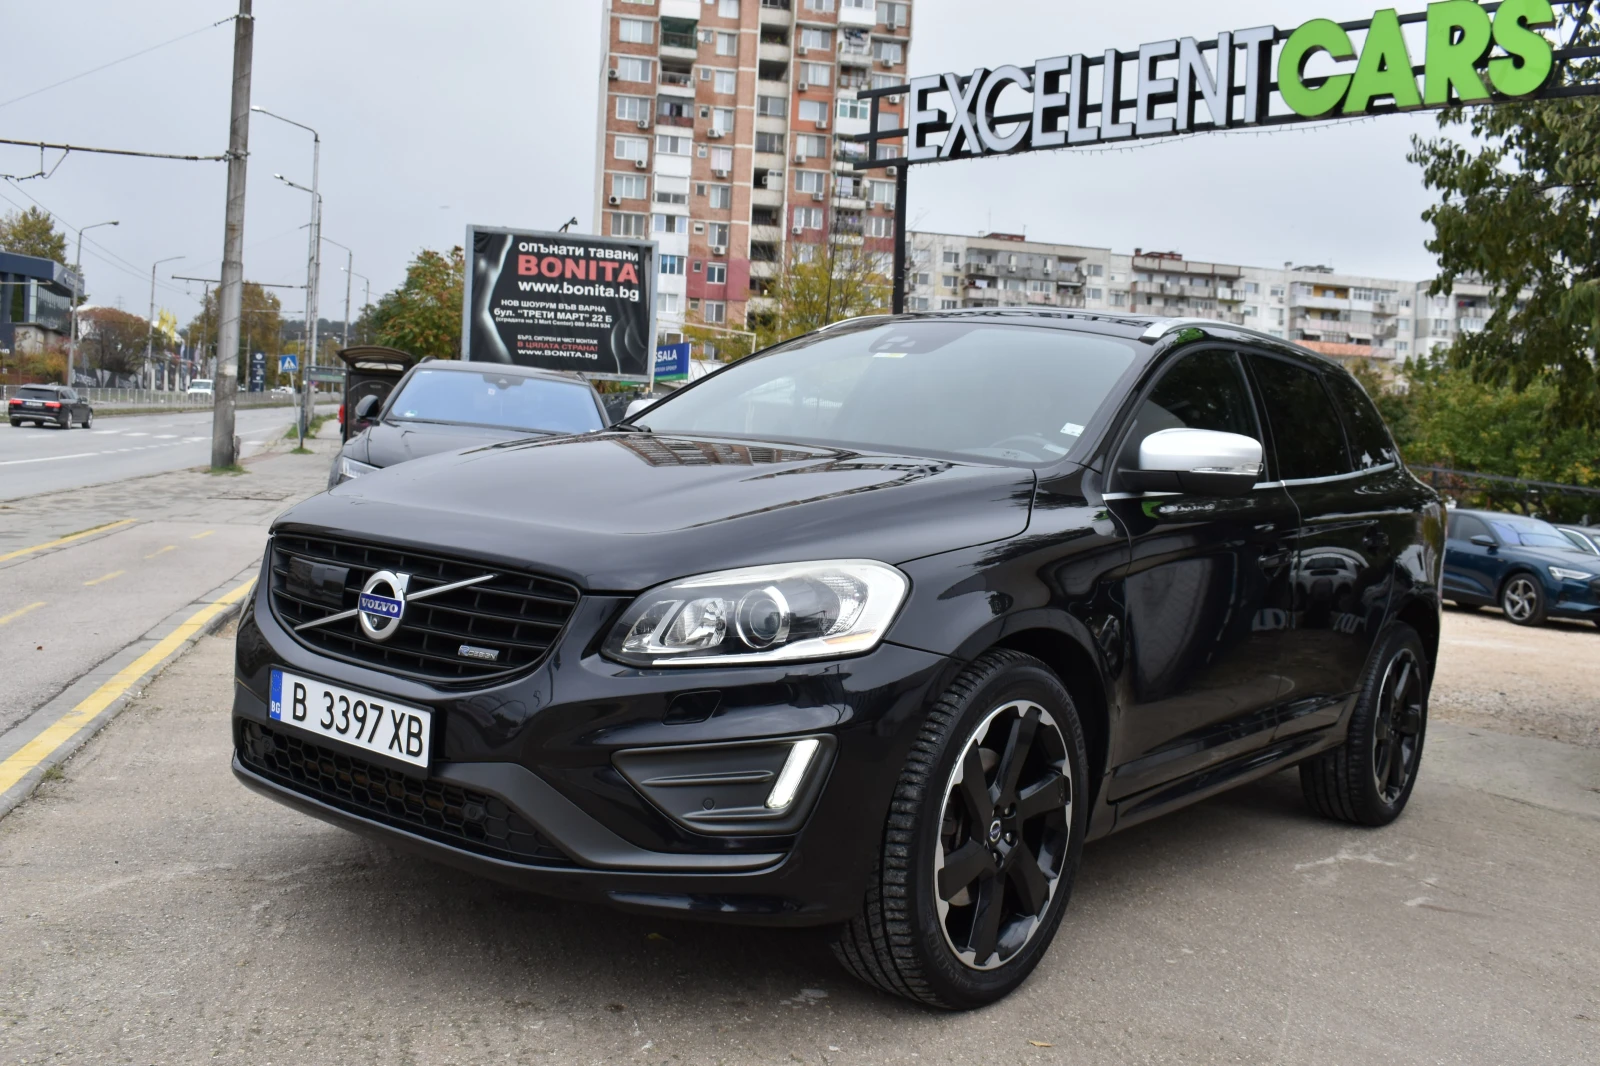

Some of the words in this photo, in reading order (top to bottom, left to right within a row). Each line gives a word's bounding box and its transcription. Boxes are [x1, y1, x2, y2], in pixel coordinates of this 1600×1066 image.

[908, 25, 1279, 162] EXCELLENT
[1277, 0, 1556, 117] CARS
[518, 242, 584, 257] опънати
[588, 247, 639, 262] тавани
[517, 254, 639, 285] BONITA
[518, 281, 639, 302] www.bonita.bg
[501, 299, 519, 307] НОВ
[521, 301, 557, 310] ШОУРУМ
[558, 303, 577, 311] ВЪВ
[578, 304, 607, 313] ВАРНА
[493, 308, 516, 318] бул.
[591, 314, 604, 323] 22
[605, 315, 613, 323] Б
[517, 348, 598, 361] www.BONITA.bg
[525, 342, 560, 350] ЦЯЛАТА
[361, 597, 399, 614] VOLVO
[271, 700, 281, 714] BG
[292, 681, 307, 722] B
[320, 690, 384, 744] 3397
[388, 709, 423, 758] XB
